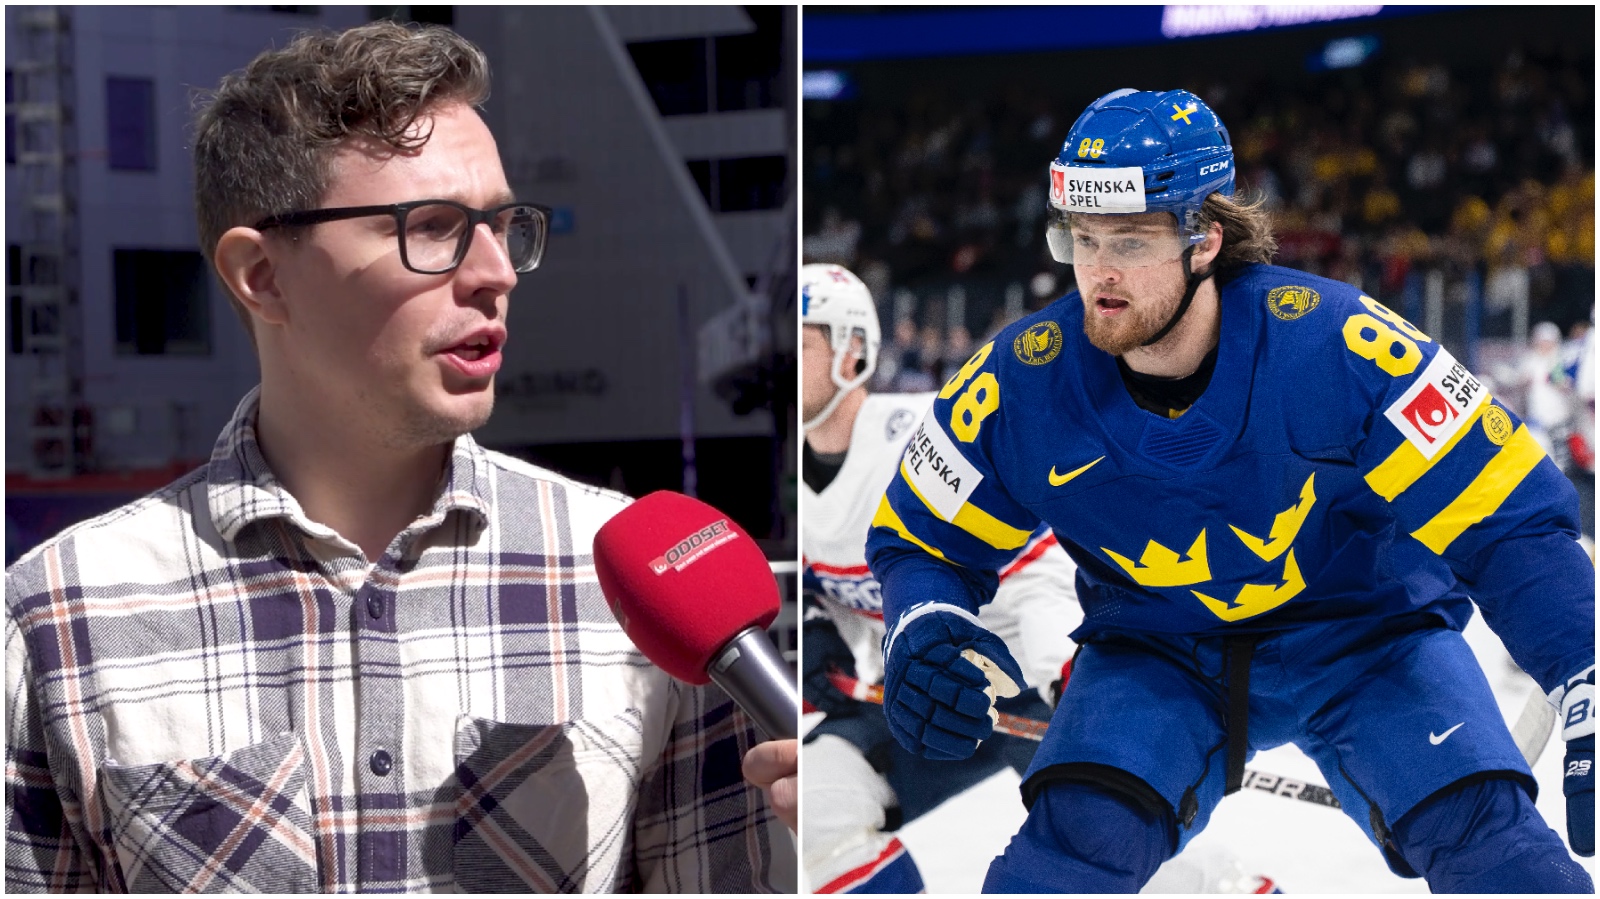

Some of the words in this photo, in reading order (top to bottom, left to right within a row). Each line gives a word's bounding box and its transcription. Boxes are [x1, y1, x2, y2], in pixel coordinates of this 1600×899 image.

[1078, 138, 1104, 158] 88
[1200, 160, 1229, 177] CCM
[1068, 179, 1136, 194] SVENSKA
[1069, 195, 1101, 207] SPEL
[1342, 295, 1432, 377] 88
[938, 341, 999, 443] 88
[1455, 376, 1480, 408] SPEL
[666, 521, 728, 564] ODDSET
[1564, 698, 1595, 730] B
